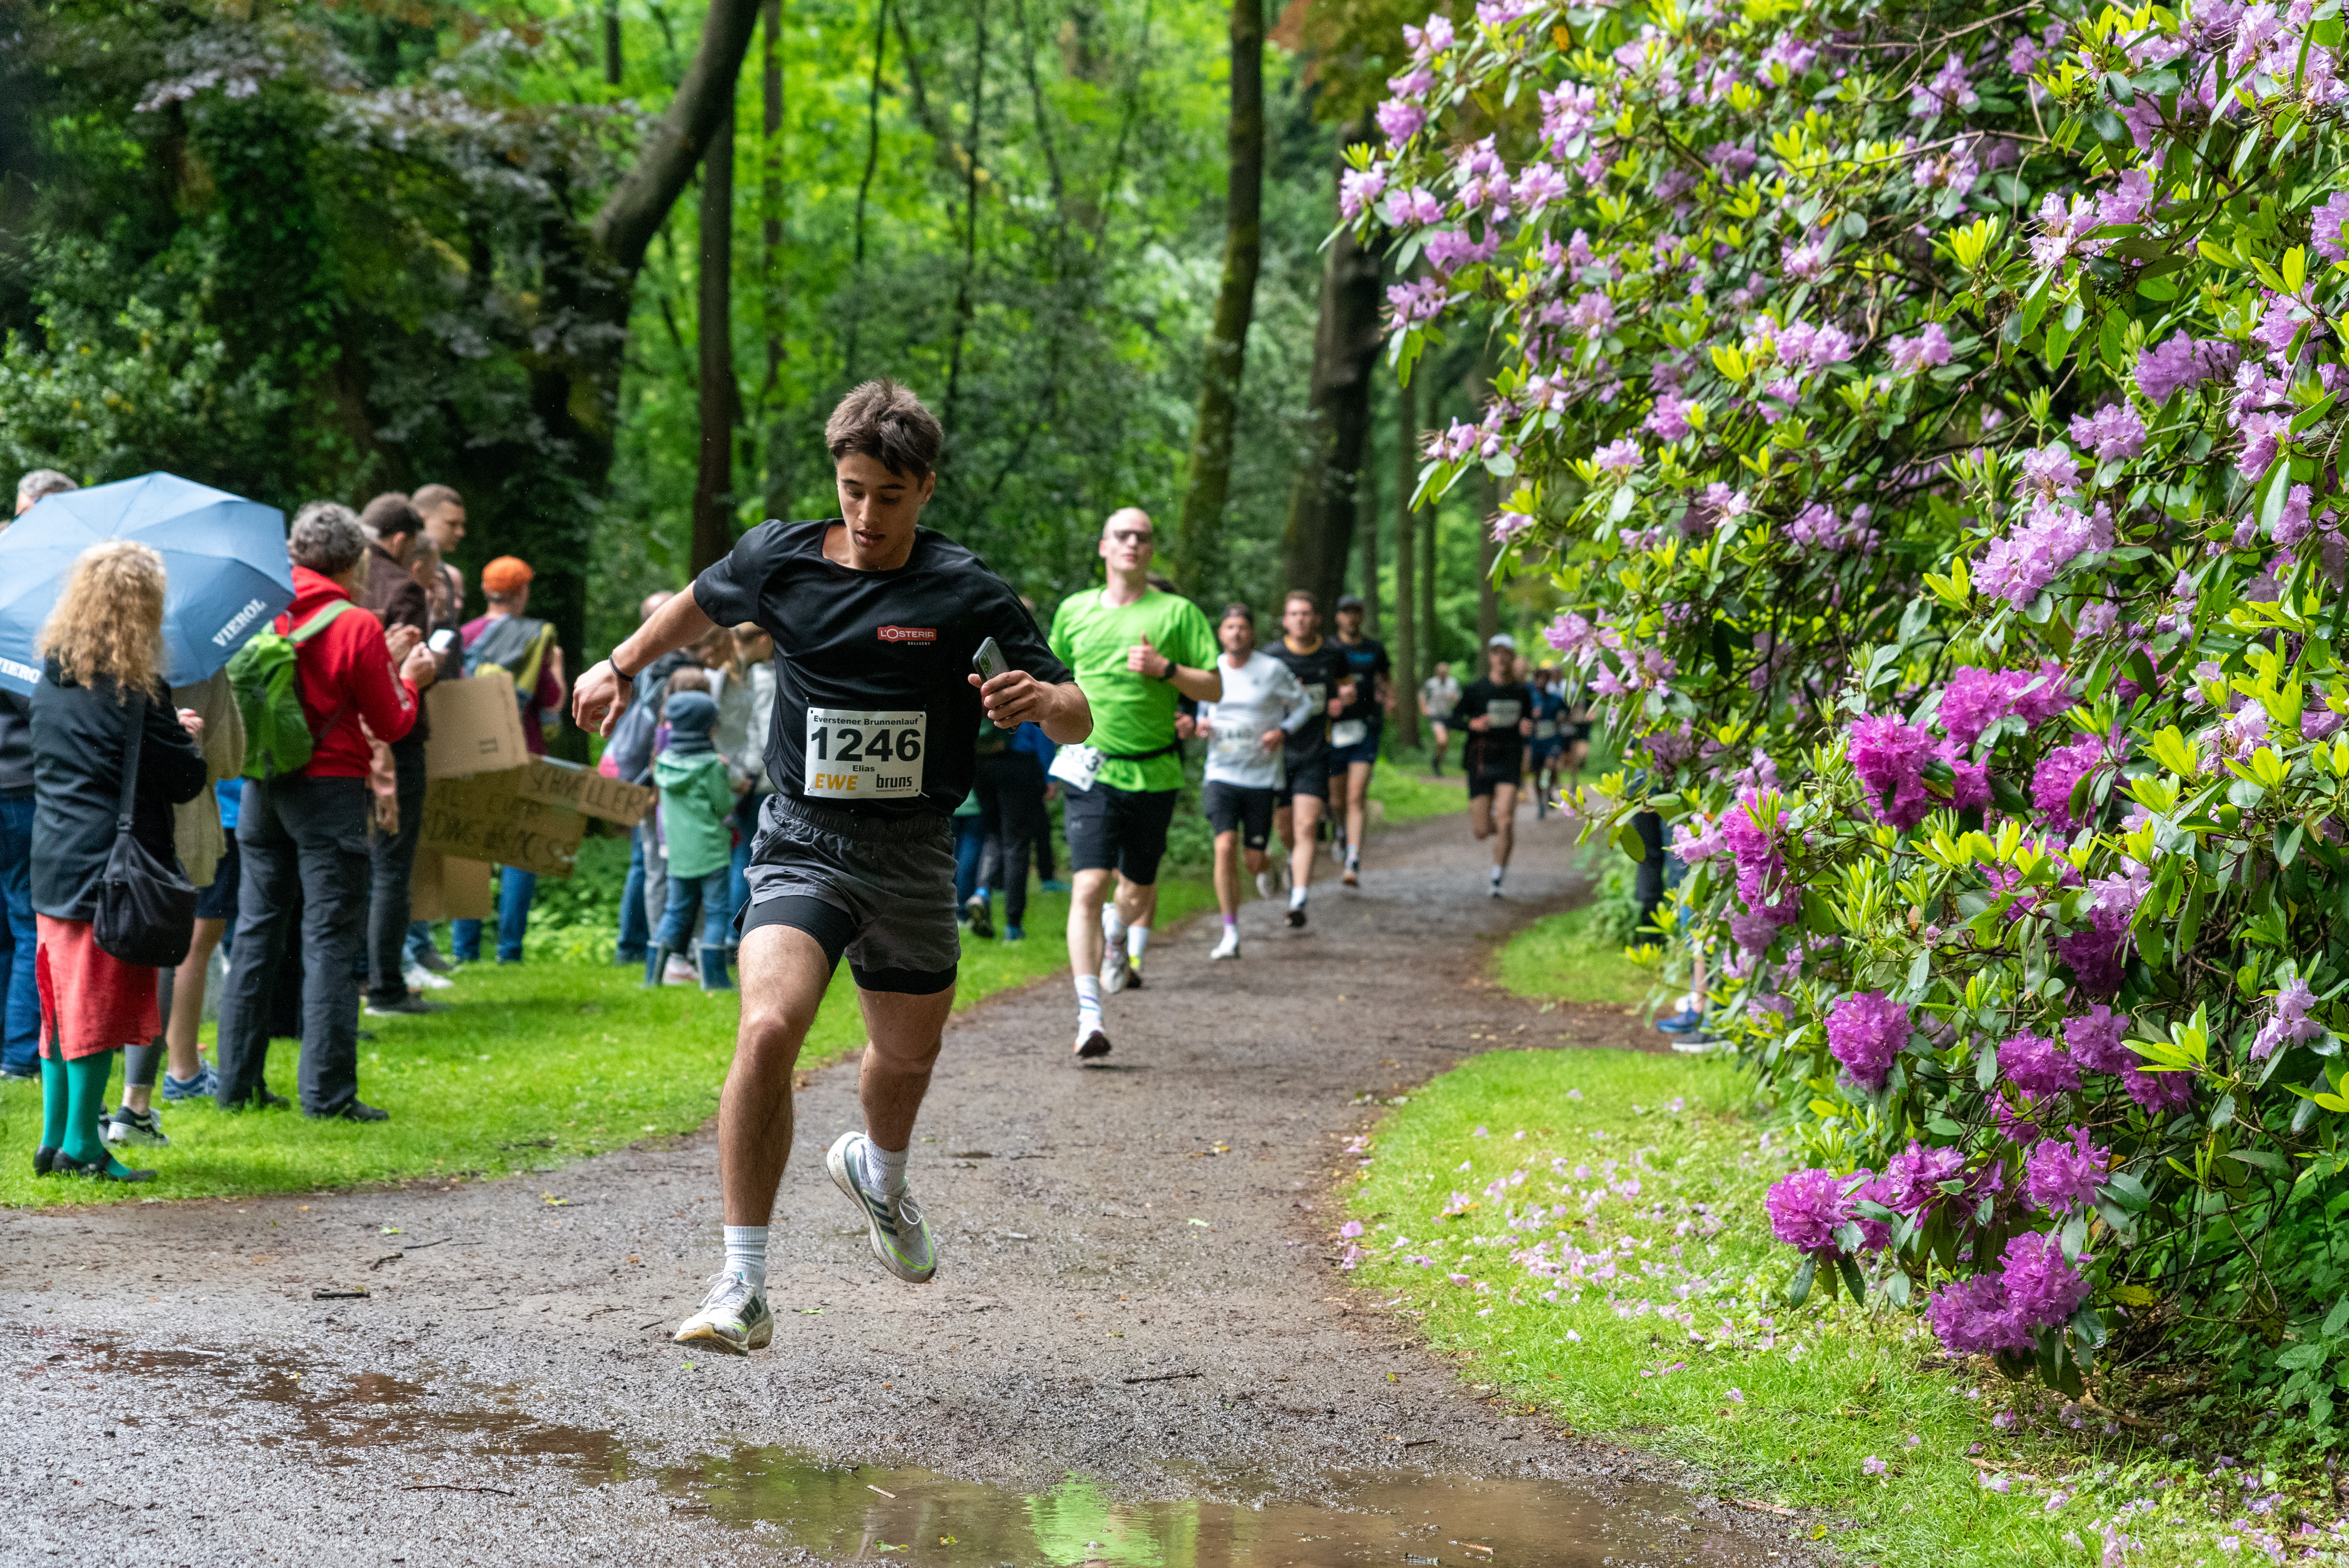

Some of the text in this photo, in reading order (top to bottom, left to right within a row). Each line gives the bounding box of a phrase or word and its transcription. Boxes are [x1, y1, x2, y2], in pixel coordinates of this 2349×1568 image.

[212, 599, 268, 646] VIEROL
[0, 657, 41, 684] IERO
[813, 715, 861, 725] Everstener
[811, 726, 921, 762] 1246
[814, 773, 859, 791] EWE
[876, 774, 912, 788] bruns
